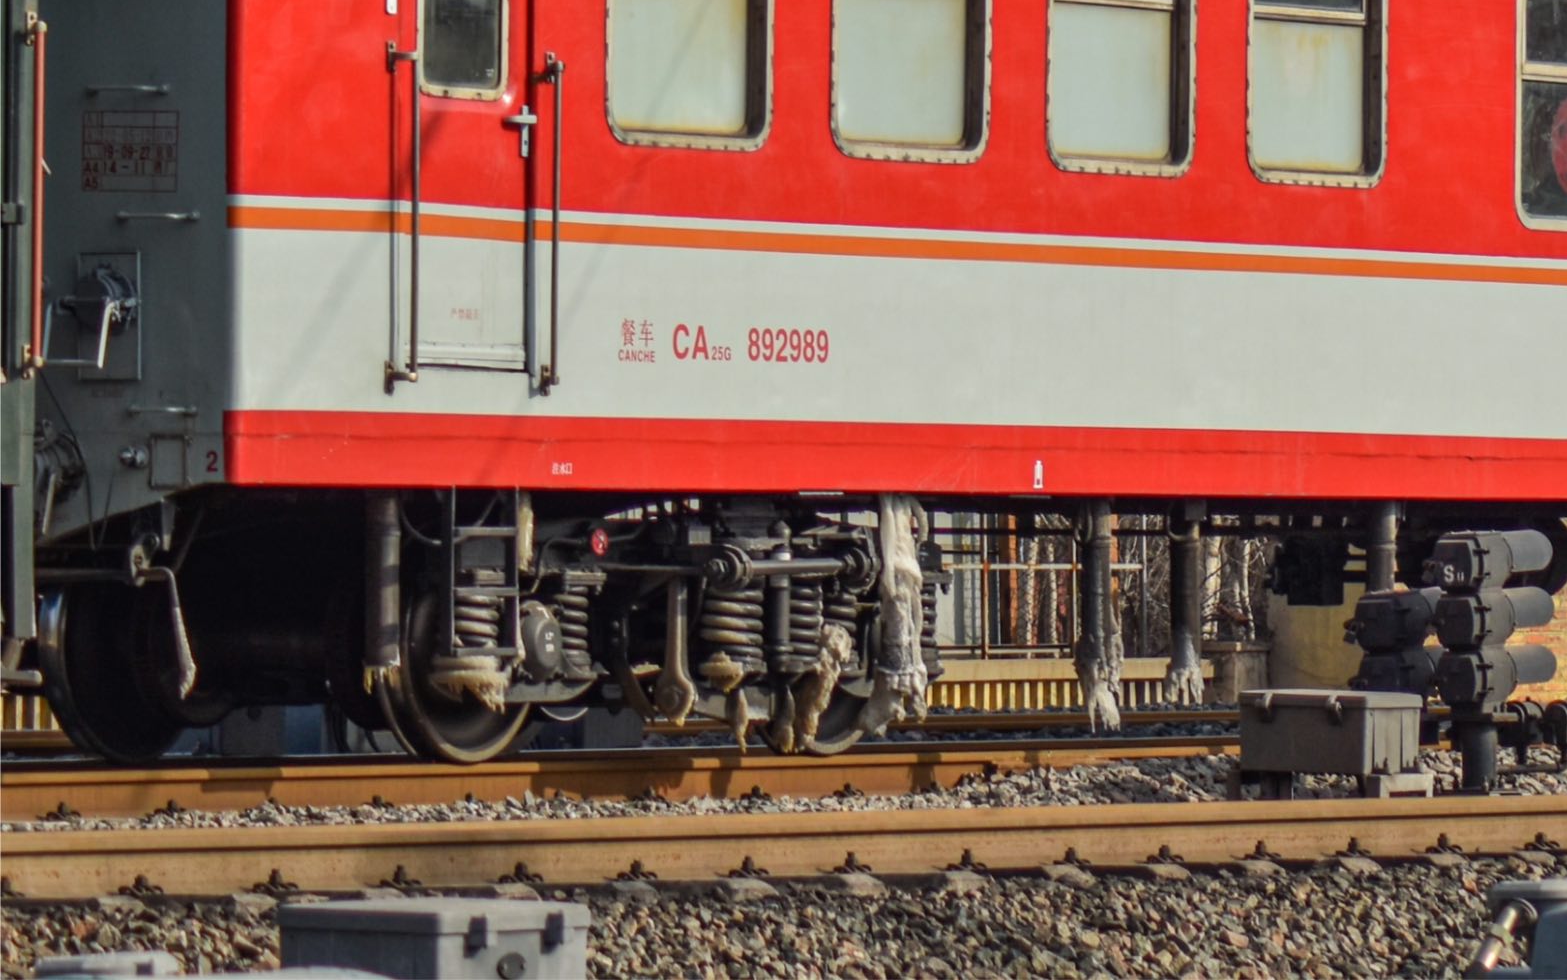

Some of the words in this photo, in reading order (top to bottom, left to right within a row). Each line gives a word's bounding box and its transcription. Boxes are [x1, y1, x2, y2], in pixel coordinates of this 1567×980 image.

[621, 319, 654, 347] 餐车
[748, 327, 829, 363] 892989
[618, 348, 656, 363] CANCHE
[205, 450, 219, 472] 2
